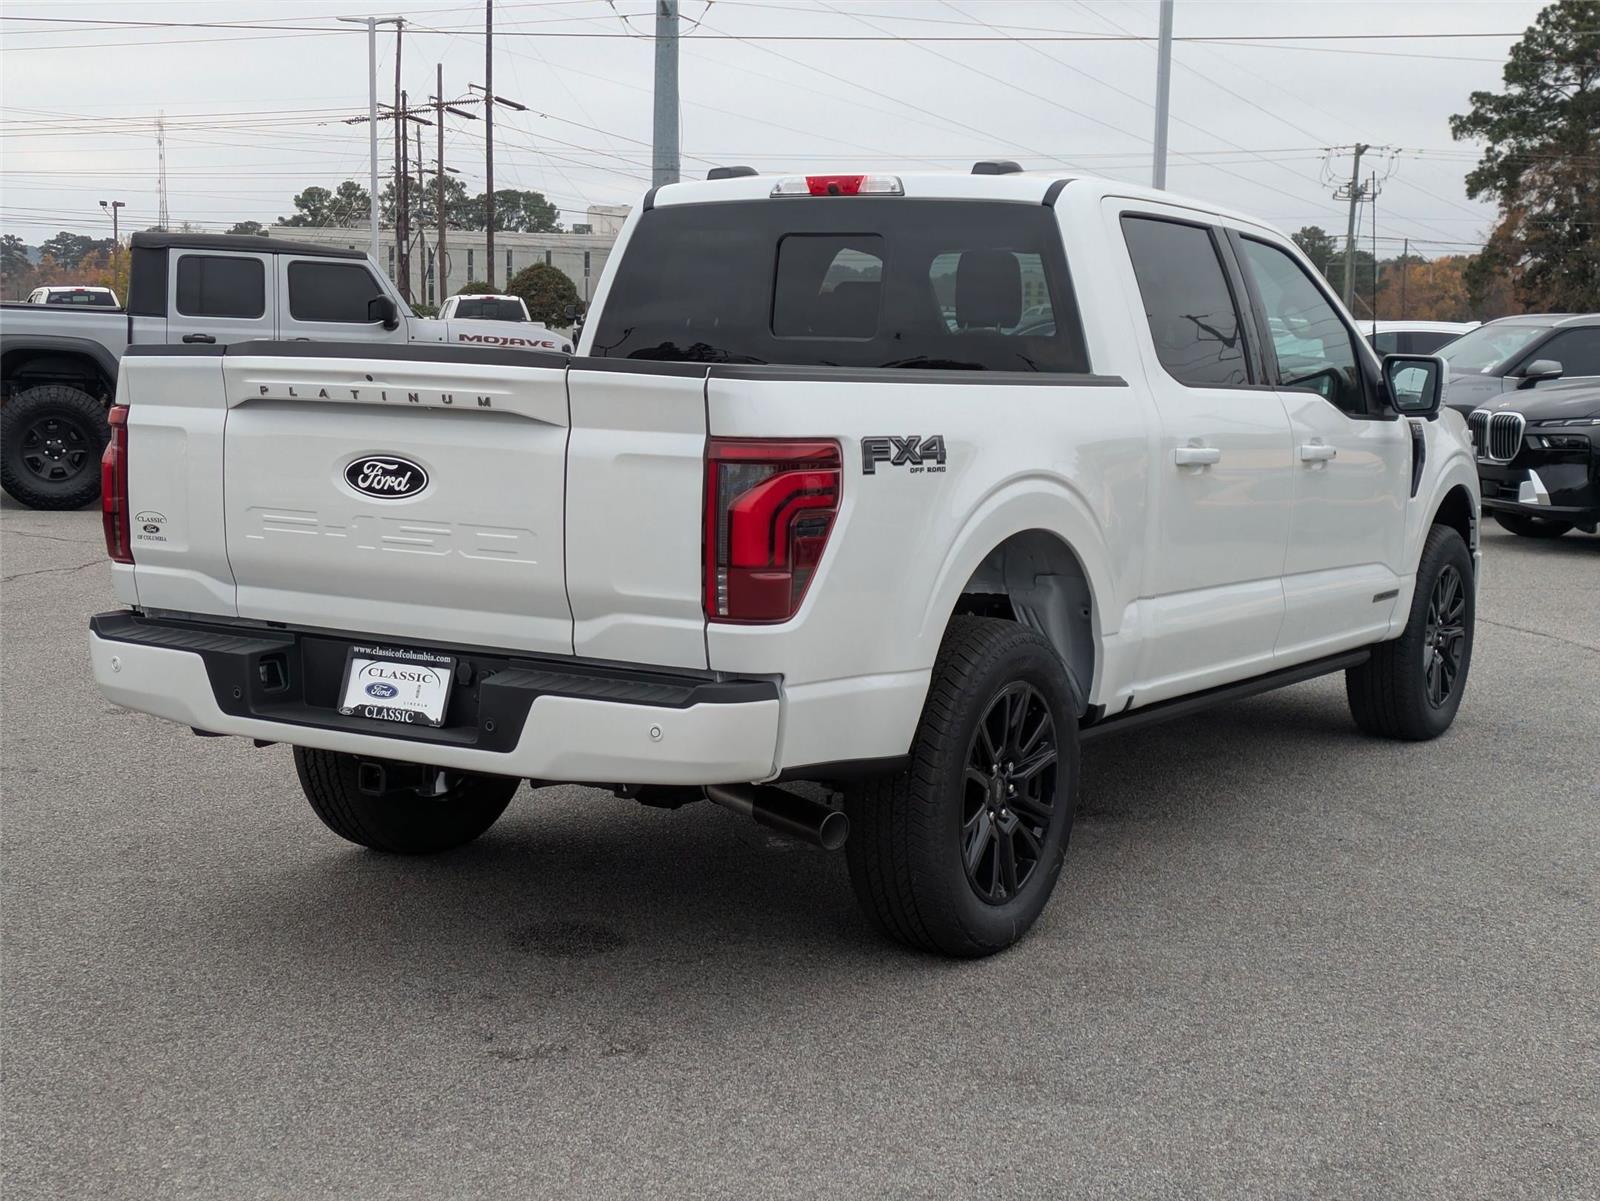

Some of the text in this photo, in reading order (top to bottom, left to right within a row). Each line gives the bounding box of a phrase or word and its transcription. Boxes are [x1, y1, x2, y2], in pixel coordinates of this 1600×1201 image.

[459, 334, 555, 349] MOJAVE
[259, 386, 492, 408] PLATINUM
[861, 435, 946, 475] FX4
[358, 461, 412, 491] Ford
[353, 645, 451, 662] www.classicofcolumbia.com
[368, 668, 433, 683] CLASSIC
[371, 684, 392, 697] Ford
[364, 706, 414, 723] CLASSIC
